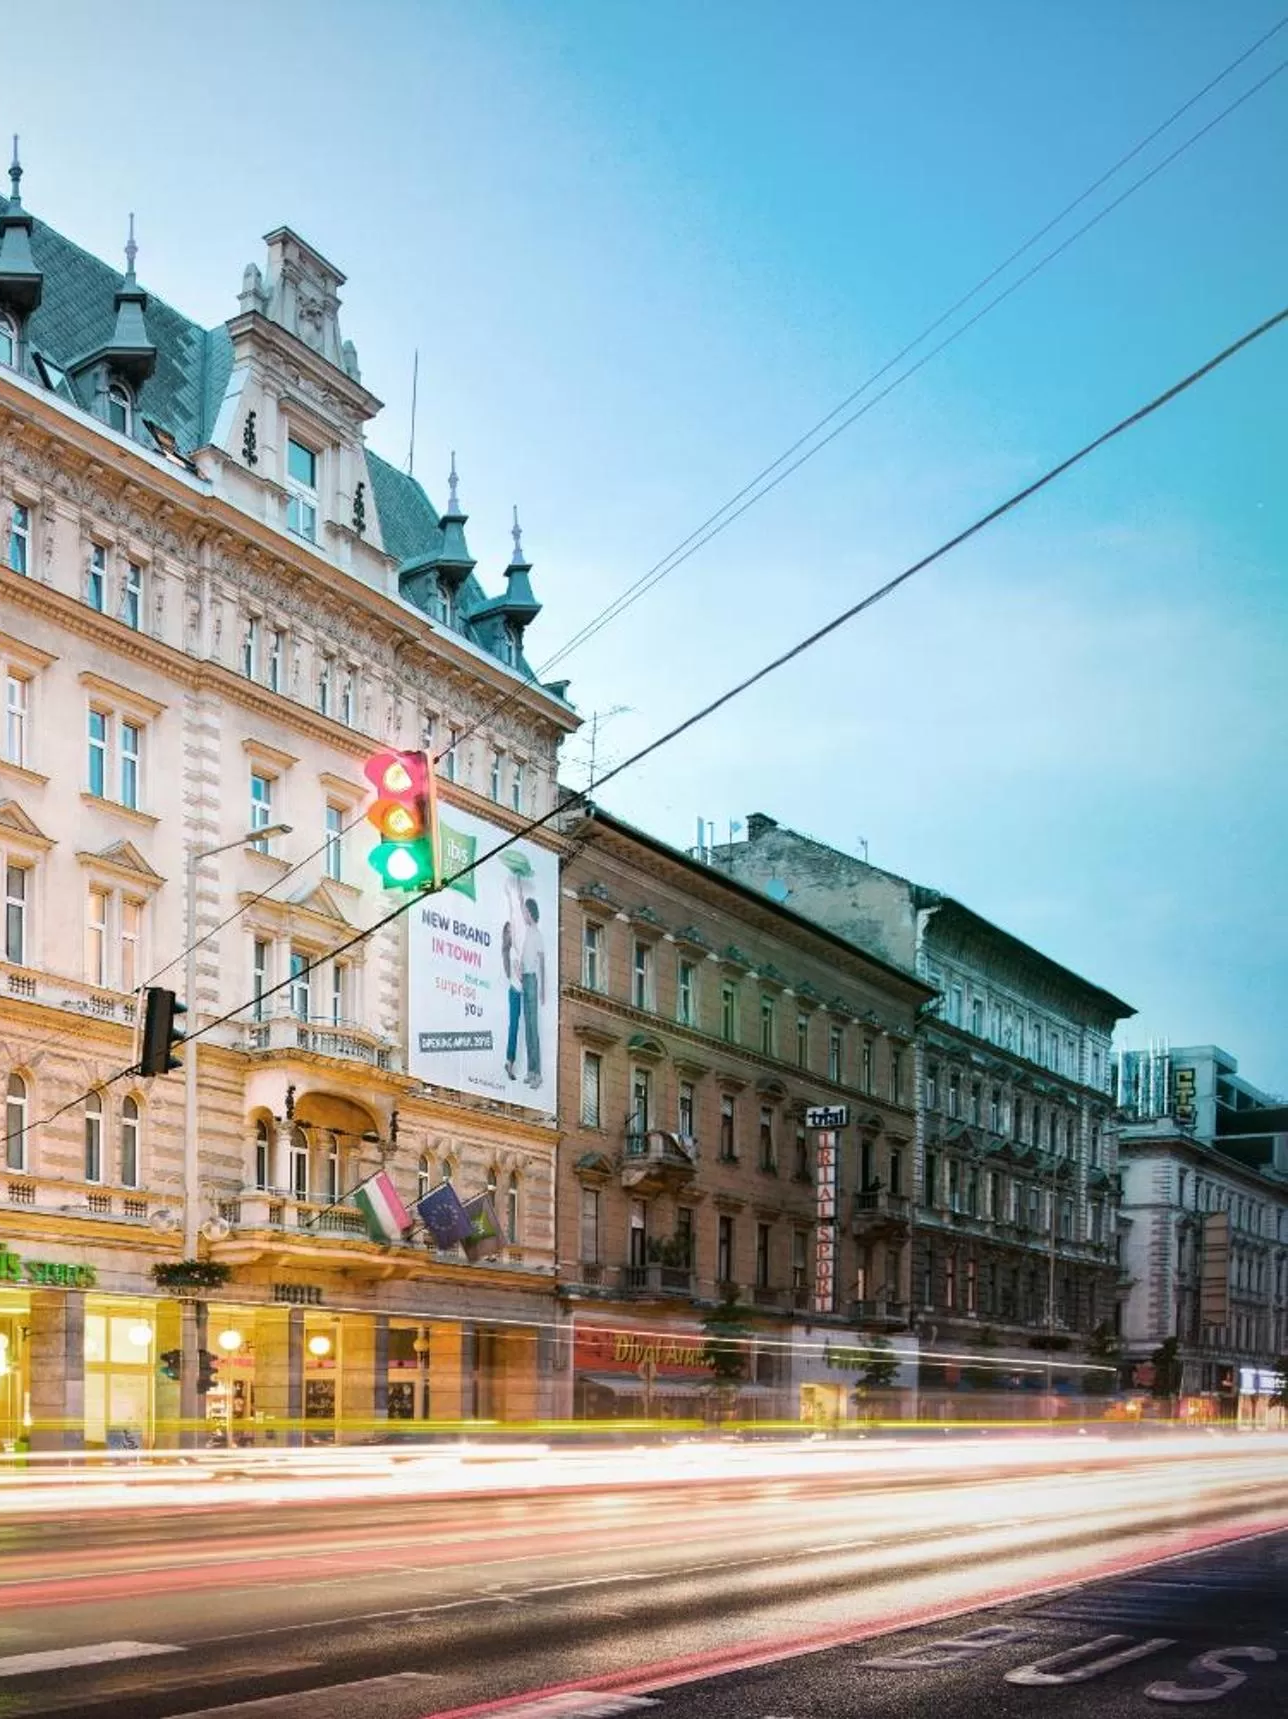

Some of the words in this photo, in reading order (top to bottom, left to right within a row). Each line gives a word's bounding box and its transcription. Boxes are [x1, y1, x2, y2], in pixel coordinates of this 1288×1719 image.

[421, 908, 450, 931] NEW
[452, 920, 491, 947] BRAND
[432, 936, 445, 956] IN
[446, 942, 482, 969] TOWN
[434, 976, 477, 1001] surprise
[464, 1003, 484, 1018] you
[808, 1106, 844, 1126] trial
[817, 1131, 834, 1219] TRIAL
[815, 1226, 832, 1314] SPORT
[854, 1624, 1278, 1703] BUS
